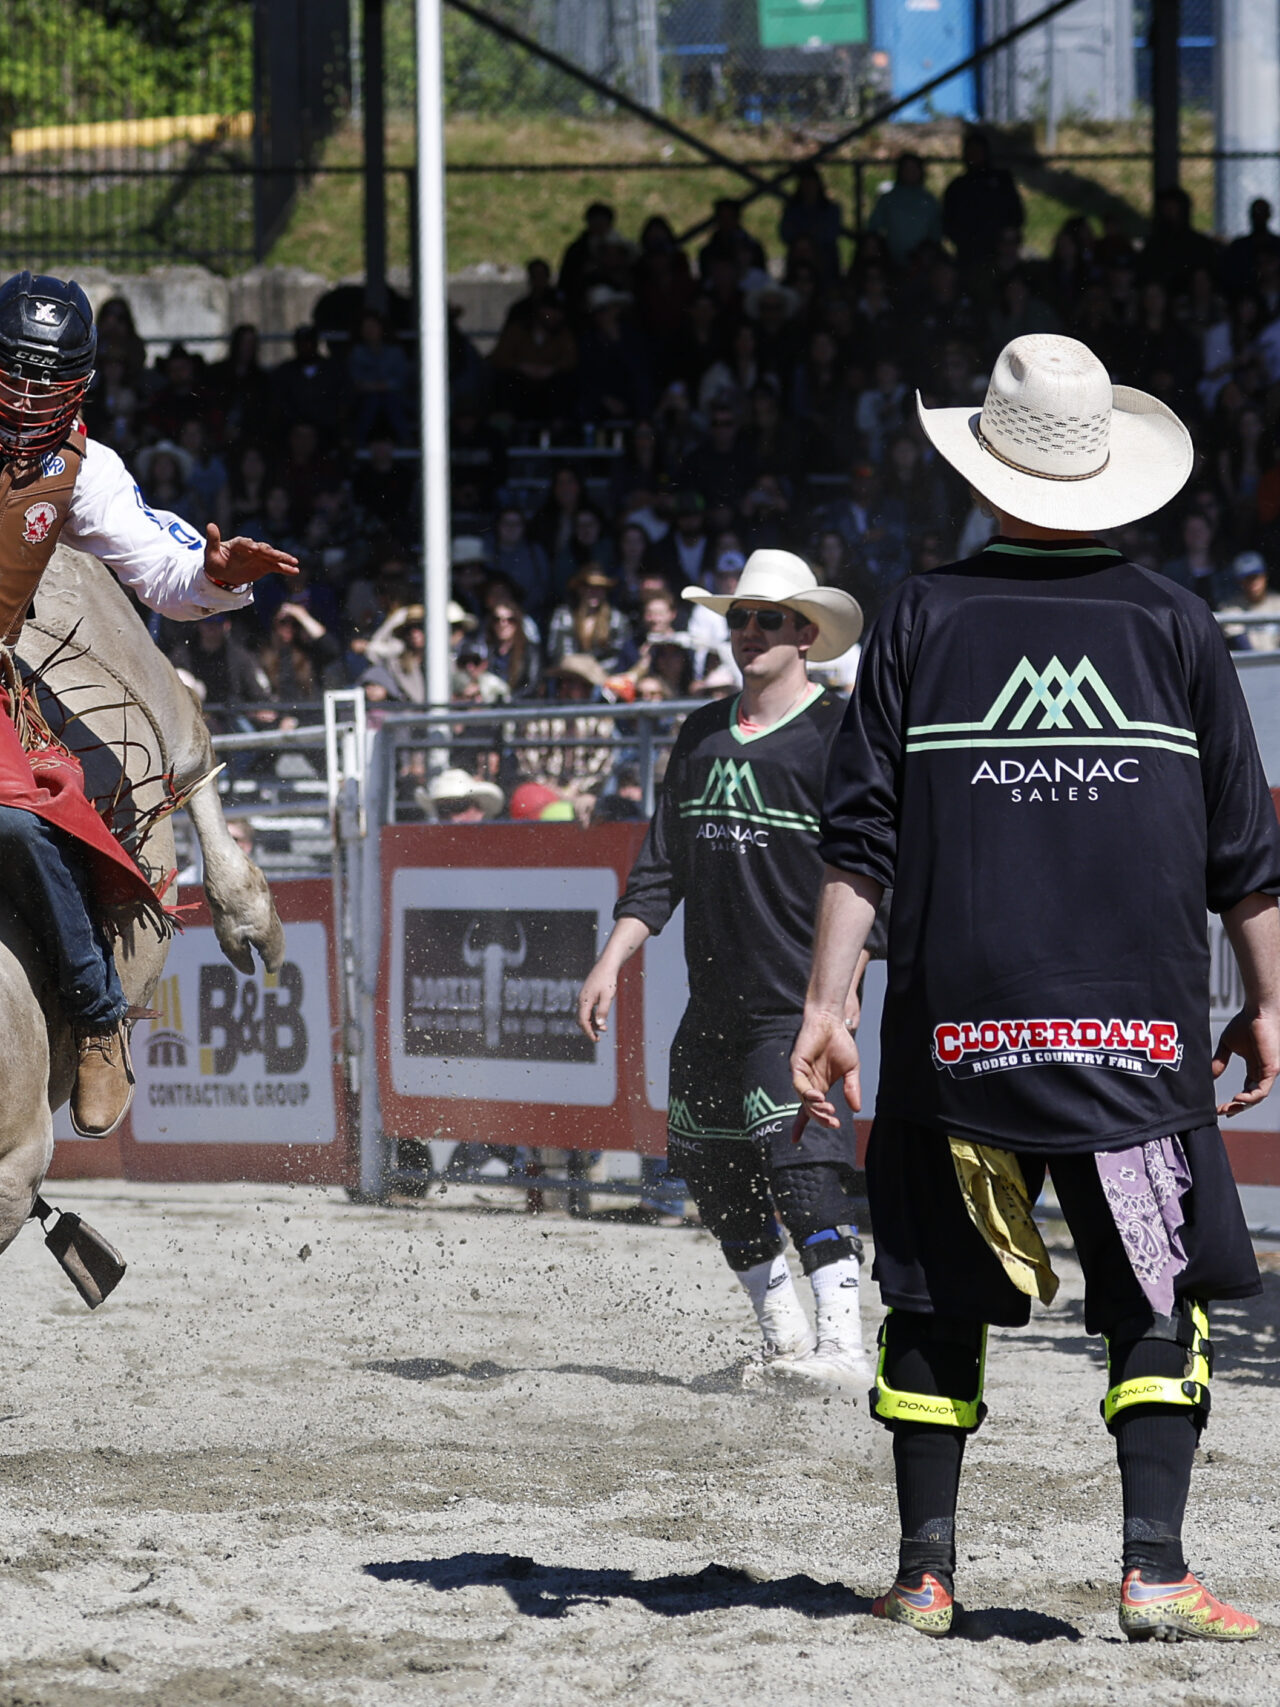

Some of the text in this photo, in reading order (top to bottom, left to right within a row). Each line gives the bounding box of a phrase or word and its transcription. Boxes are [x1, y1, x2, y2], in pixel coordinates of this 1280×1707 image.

[15, 350, 57, 366] CCM
[970, 757, 1140, 785] ADANAC
[1011, 786, 1100, 802] SALES
[695, 821, 769, 848] ADANAC
[710, 841, 747, 855] SALES
[934, 1018, 1180, 1065] CLOVERDALE
[972, 1051, 1143, 1074] RODEO & COUNTRY FAIR
[147, 1082, 311, 1108] CONTRACTING GROUP
[1112, 1385, 1164, 1404] DONJOY
[897, 1400, 960, 1415] DONJOY
